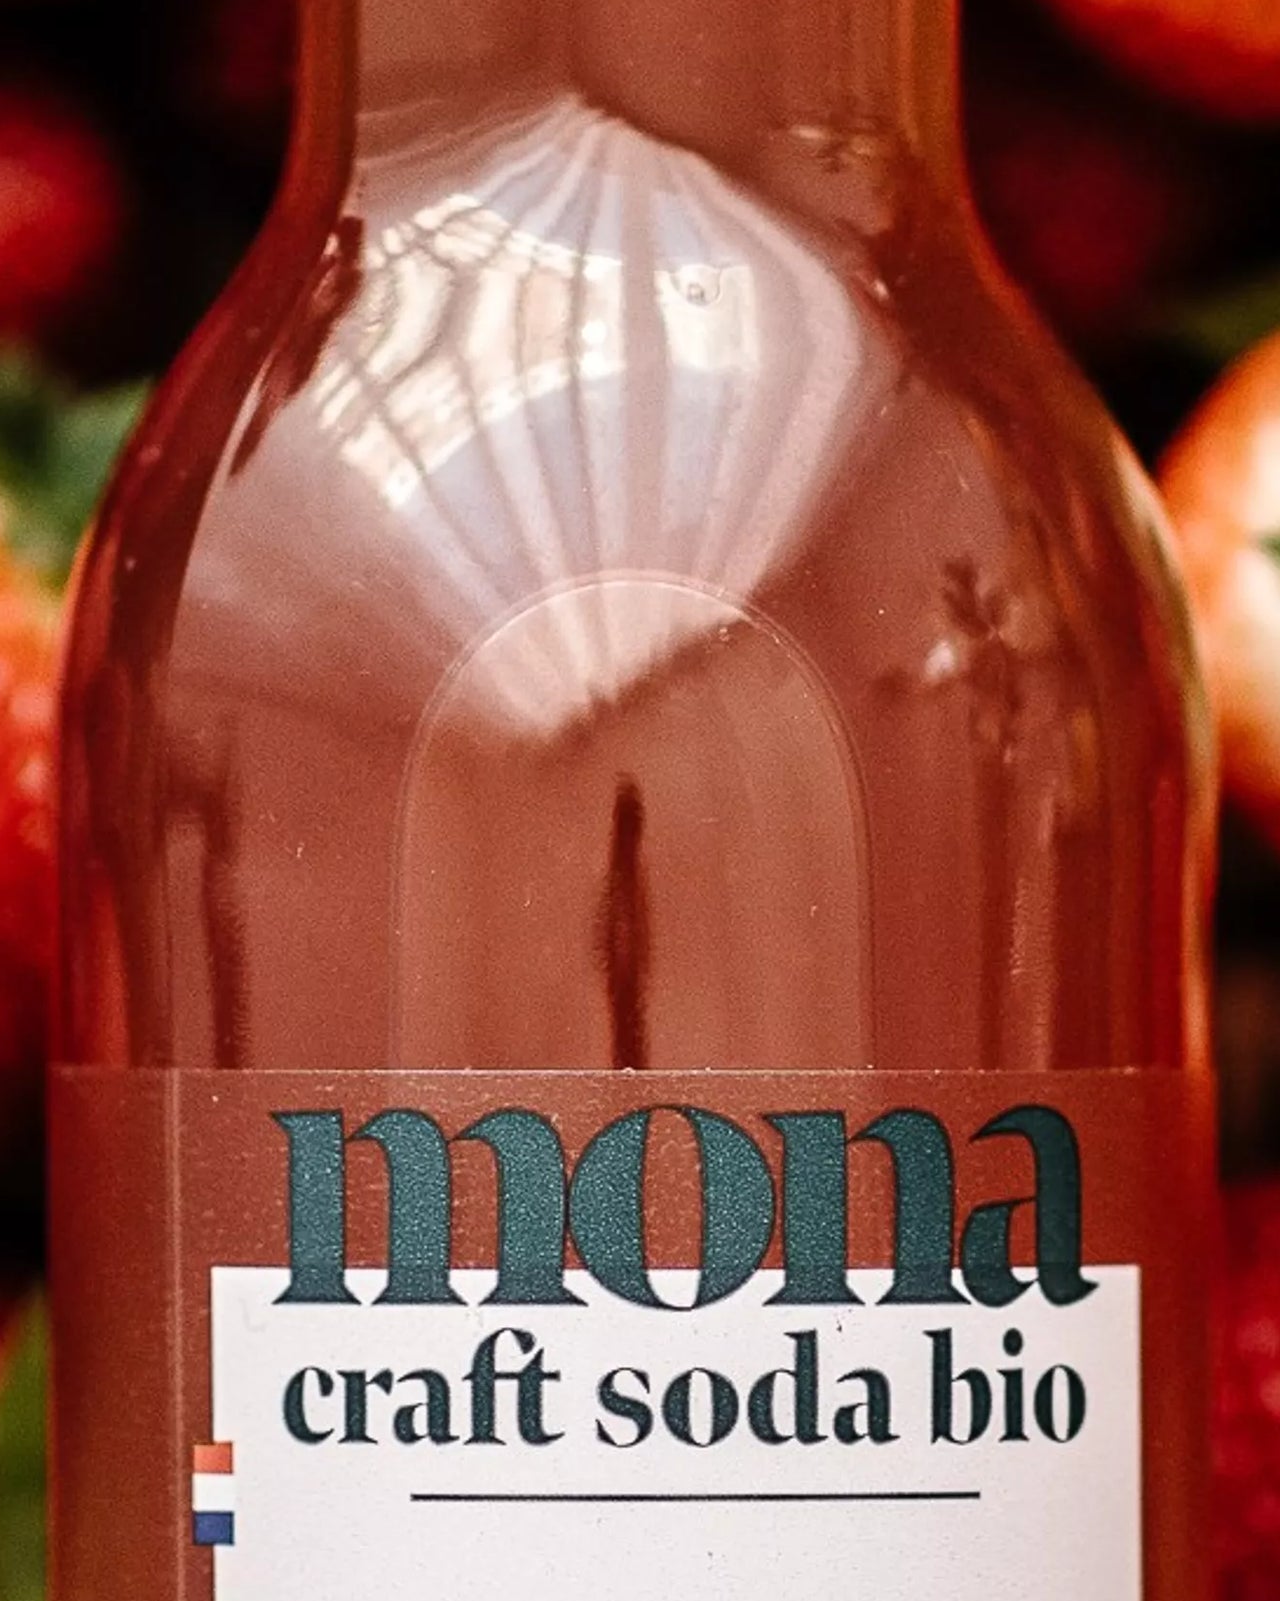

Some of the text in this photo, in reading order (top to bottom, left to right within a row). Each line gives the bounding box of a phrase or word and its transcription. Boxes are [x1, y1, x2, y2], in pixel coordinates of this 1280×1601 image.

[268, 1102, 1100, 1313] mona
[282, 1326, 1089, 1449] craft soda bio
